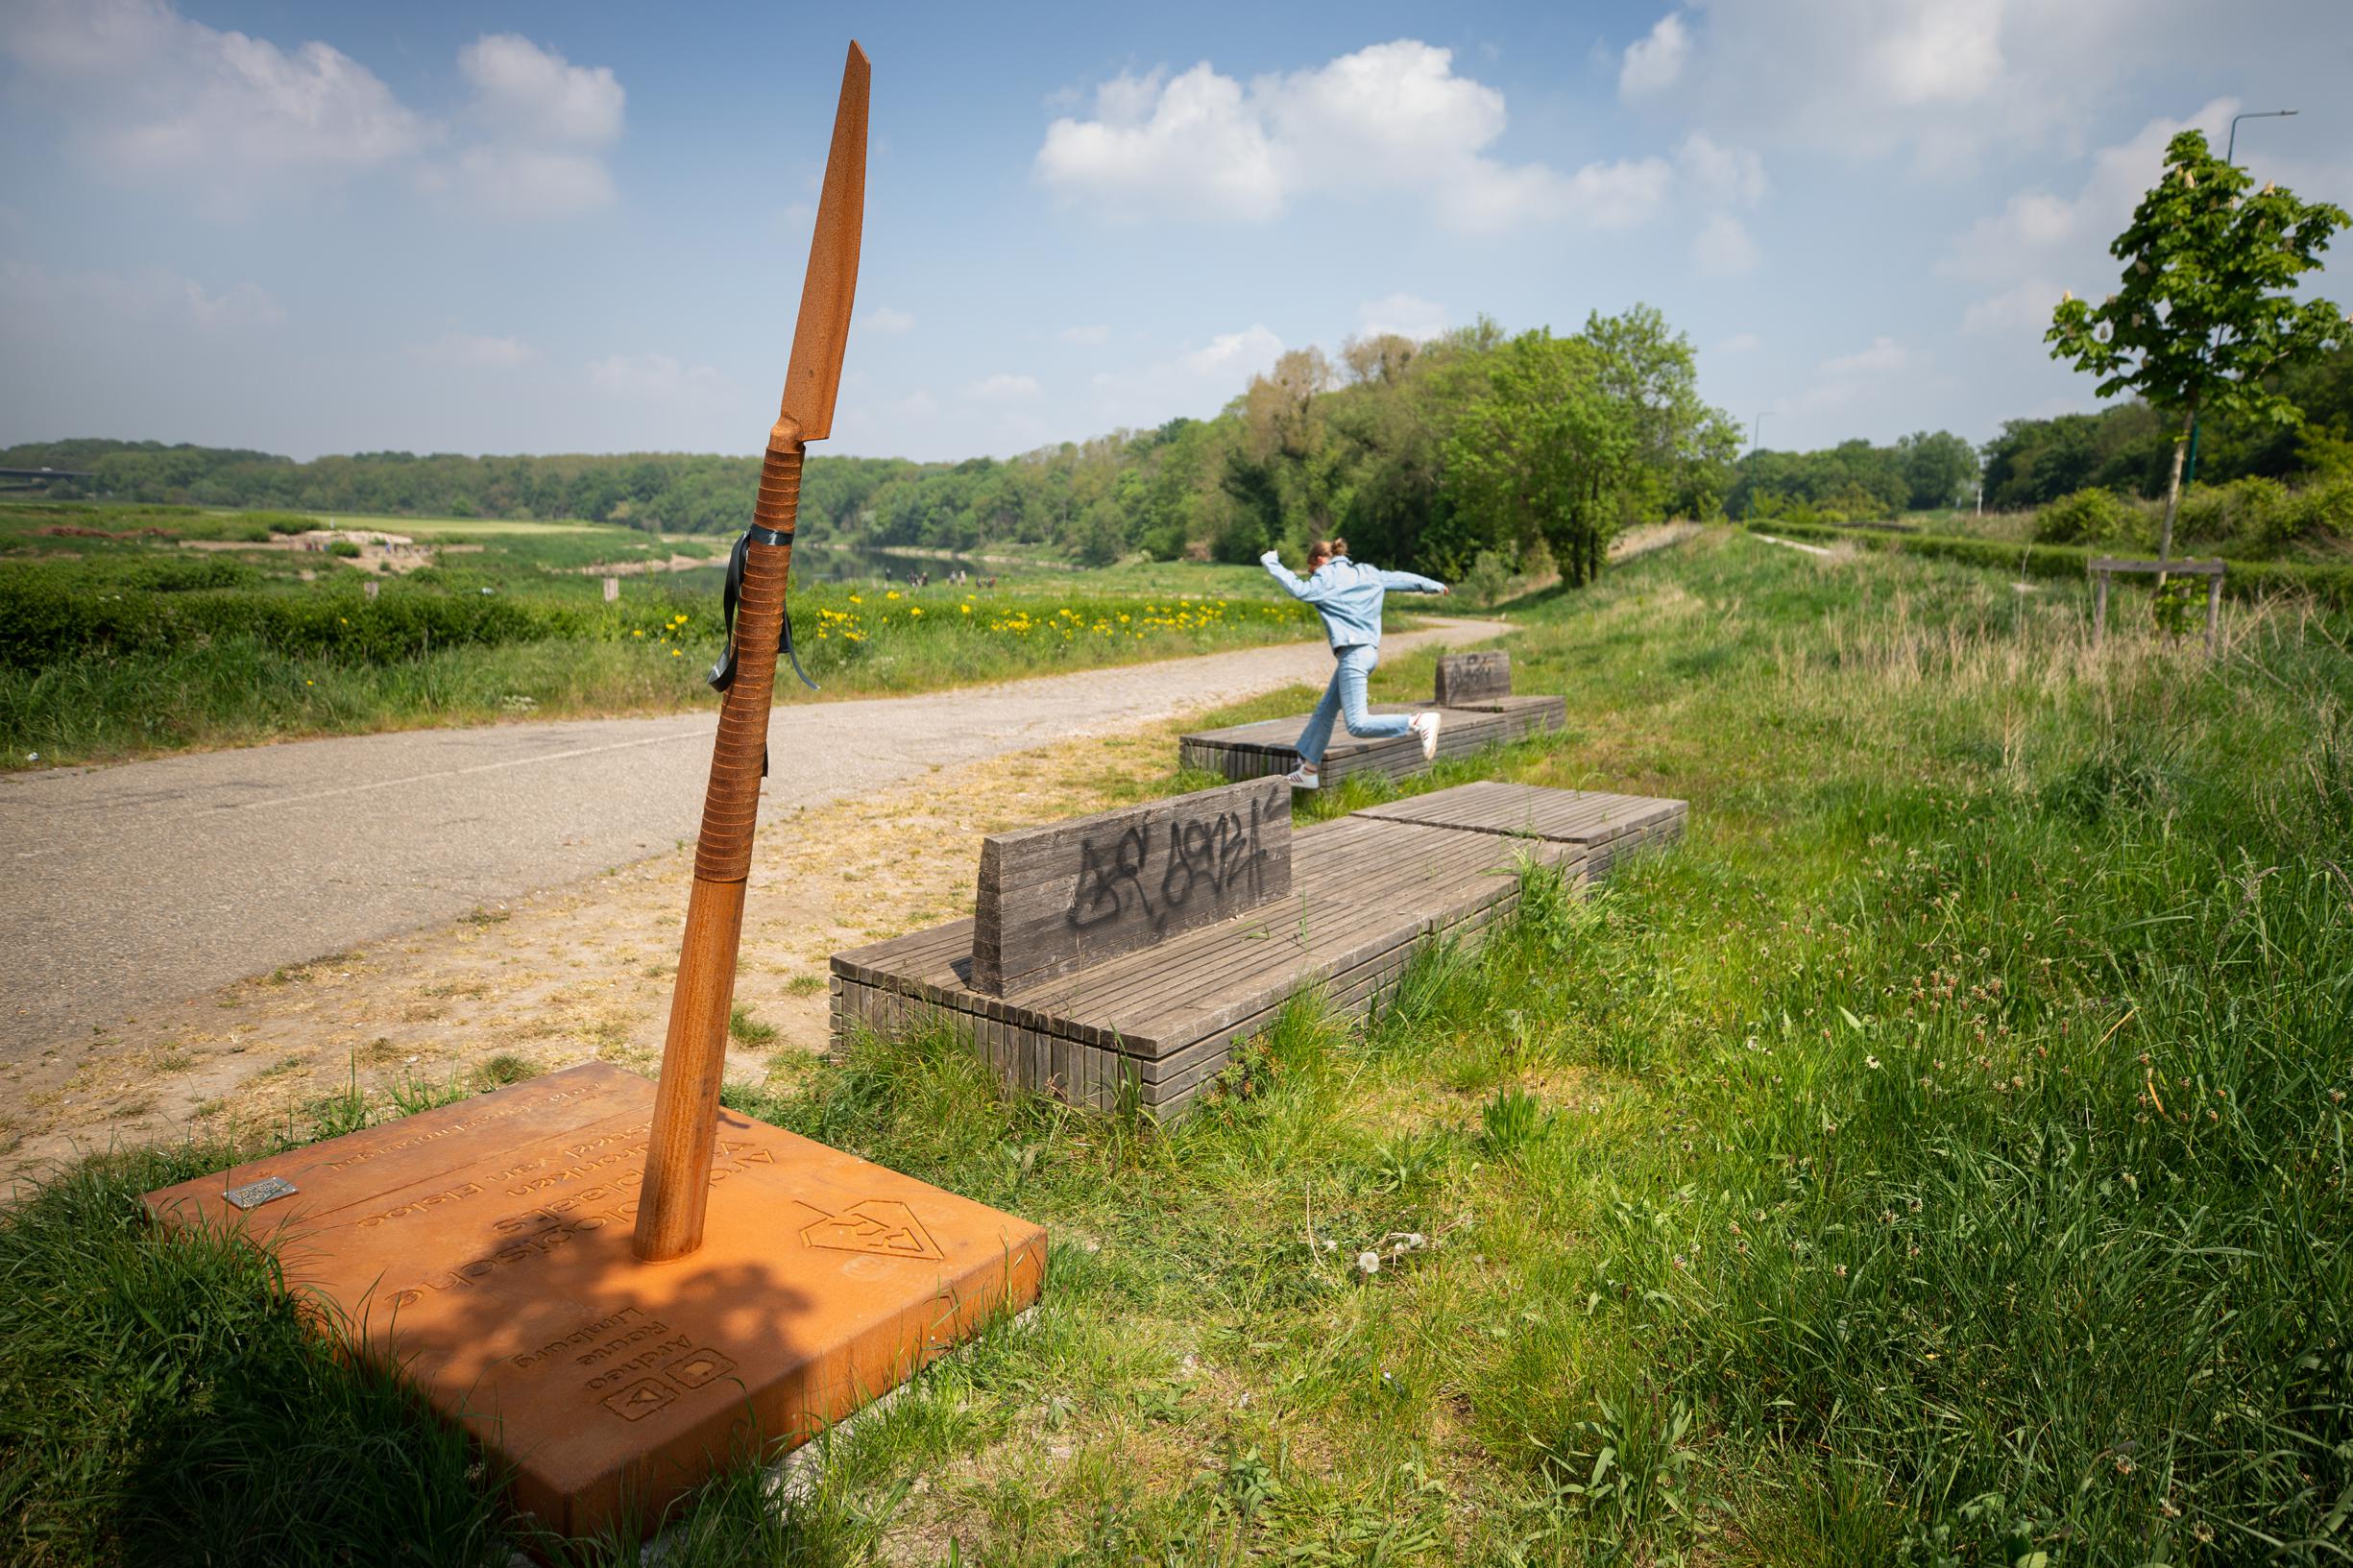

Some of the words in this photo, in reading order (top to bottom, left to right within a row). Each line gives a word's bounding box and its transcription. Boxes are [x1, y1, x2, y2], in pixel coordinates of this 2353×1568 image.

[486, 1156, 562, 1183] van
[355, 1181, 485, 1229] Elsloo
[383, 1148, 775, 1308] Arcologische
[512, 1307, 644, 1369] Limburg
[575, 1320, 669, 1367] Route
[586, 1334, 693, 1390] Archeo
